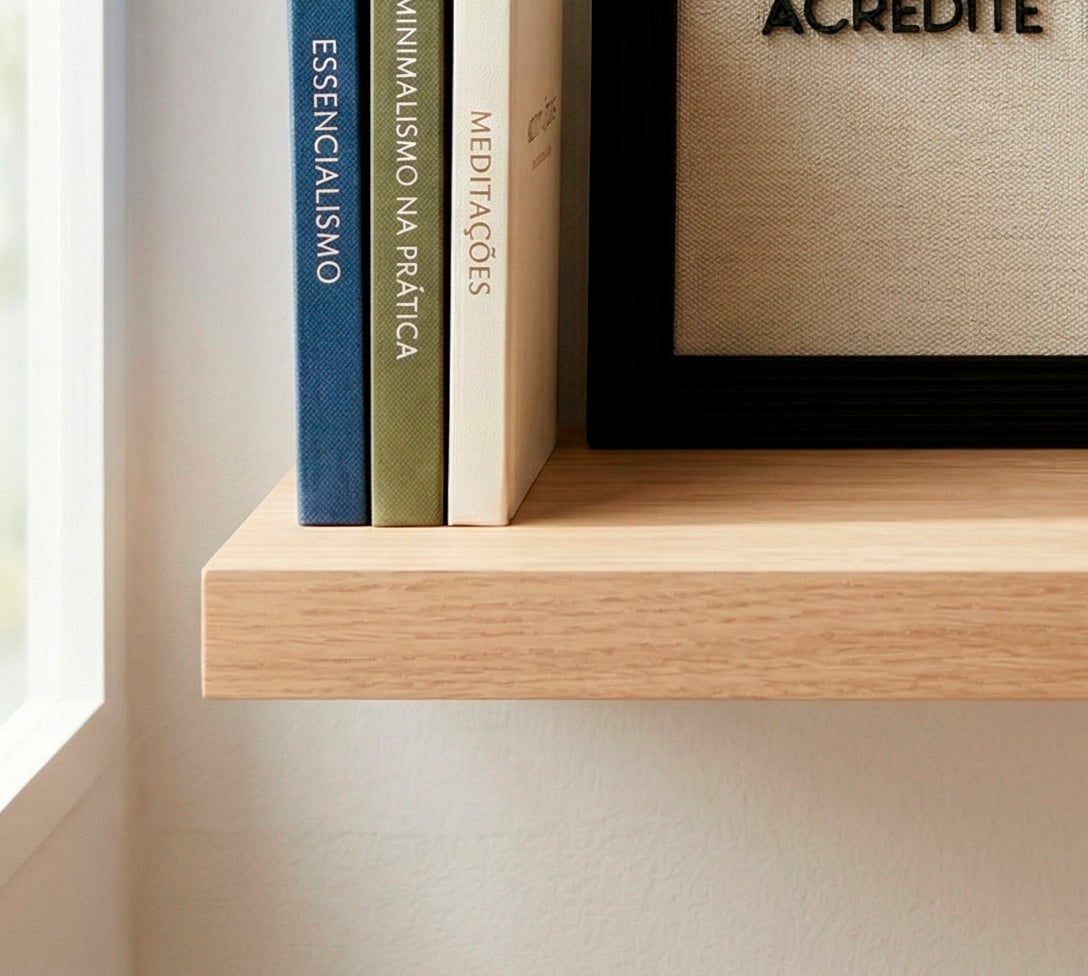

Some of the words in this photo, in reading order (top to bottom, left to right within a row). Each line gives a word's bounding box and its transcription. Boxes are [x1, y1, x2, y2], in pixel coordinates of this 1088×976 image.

[311, 38, 342, 285] ESSENCIALISMO
[395, 196, 418, 237] NA
[463, 110, 497, 296] MEDITAÇÕES
[395, 245, 425, 361] PRÁTICA
